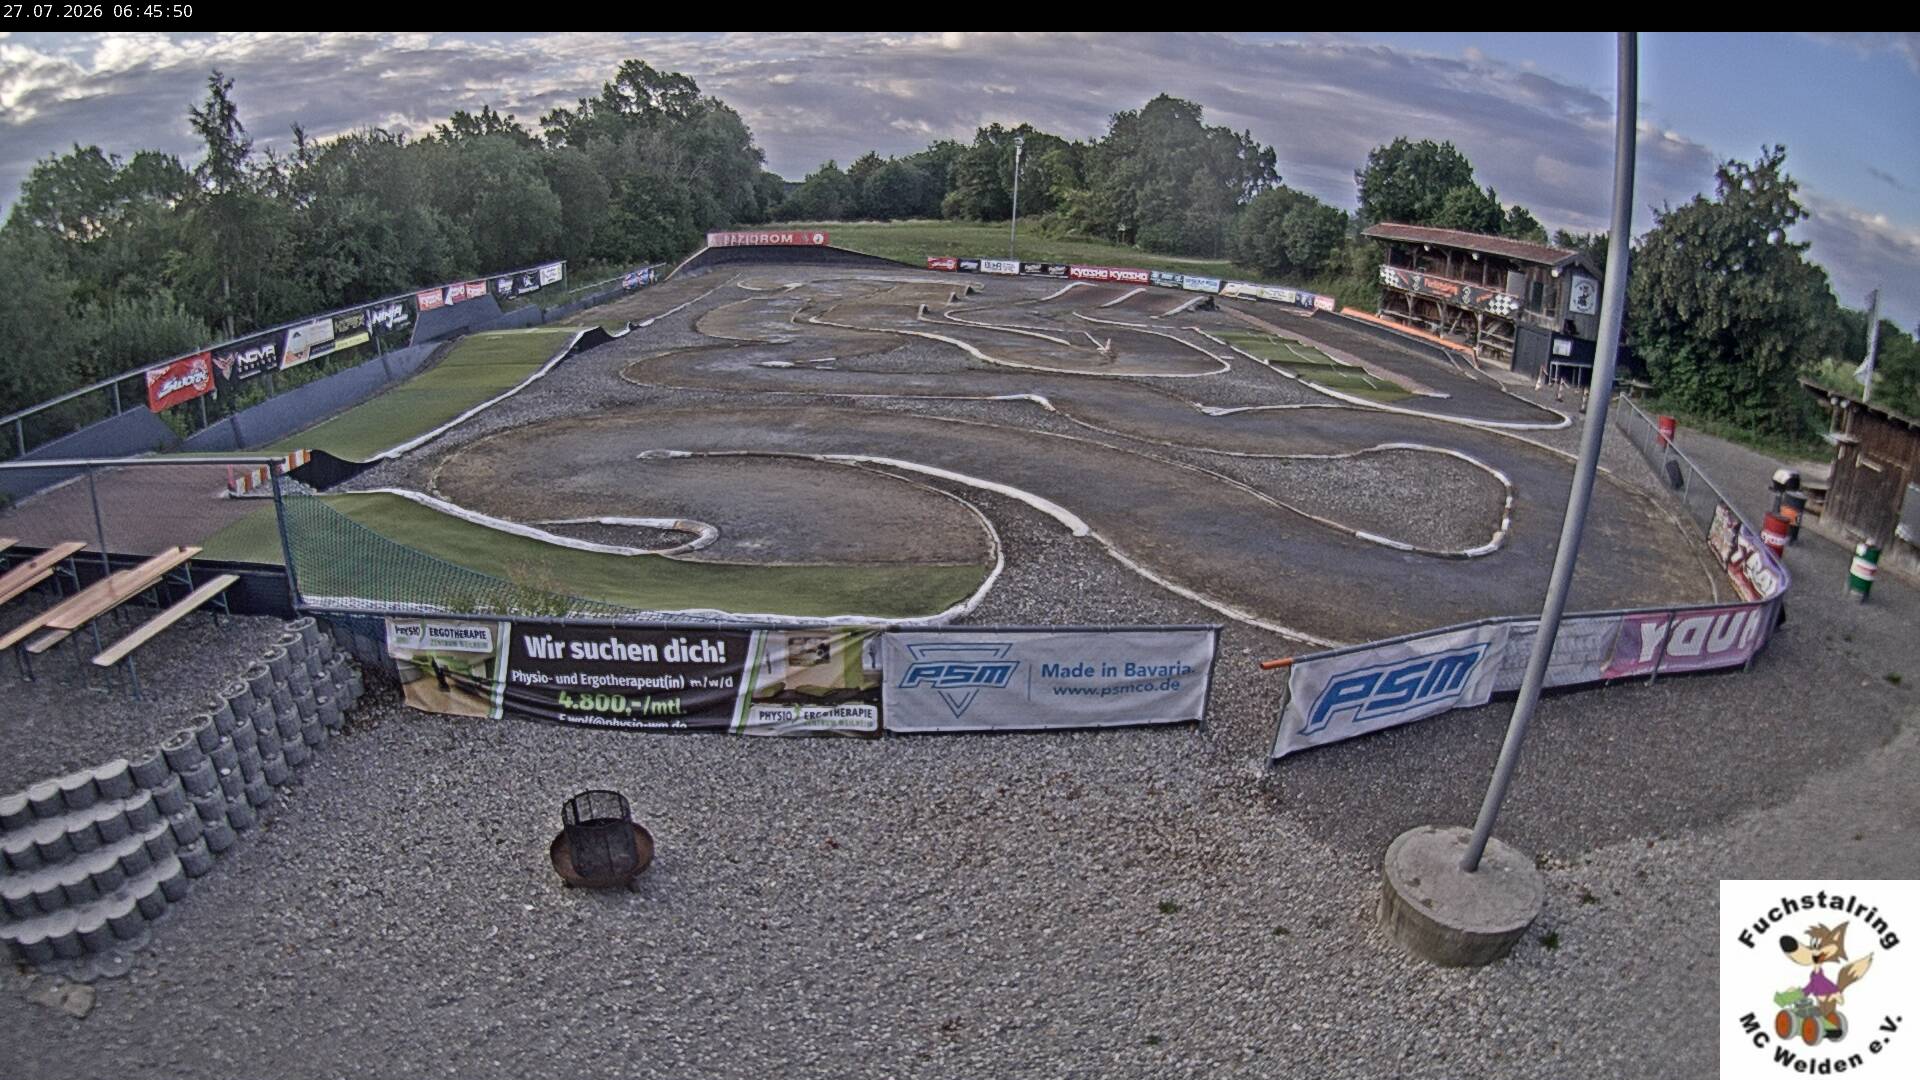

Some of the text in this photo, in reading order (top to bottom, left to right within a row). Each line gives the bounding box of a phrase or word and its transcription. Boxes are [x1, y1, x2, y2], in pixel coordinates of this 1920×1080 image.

[1070, 266, 1108, 278] KYOSHO
[1109, 269, 1148, 281] KYOSHO
[429, 627, 487, 639] ERGOTHERAPIE
[524, 635, 727, 663] Wir suchen dich!
[1041, 662, 1095, 678] Made
[1102, 662, 1117, 678] in
[512, 670, 734, 689] Physio- und Ergotherapeut(in) m/w/d
[1053, 679, 1181, 697] www.psmco.de
[760, 711, 793, 721] PHYSIO
